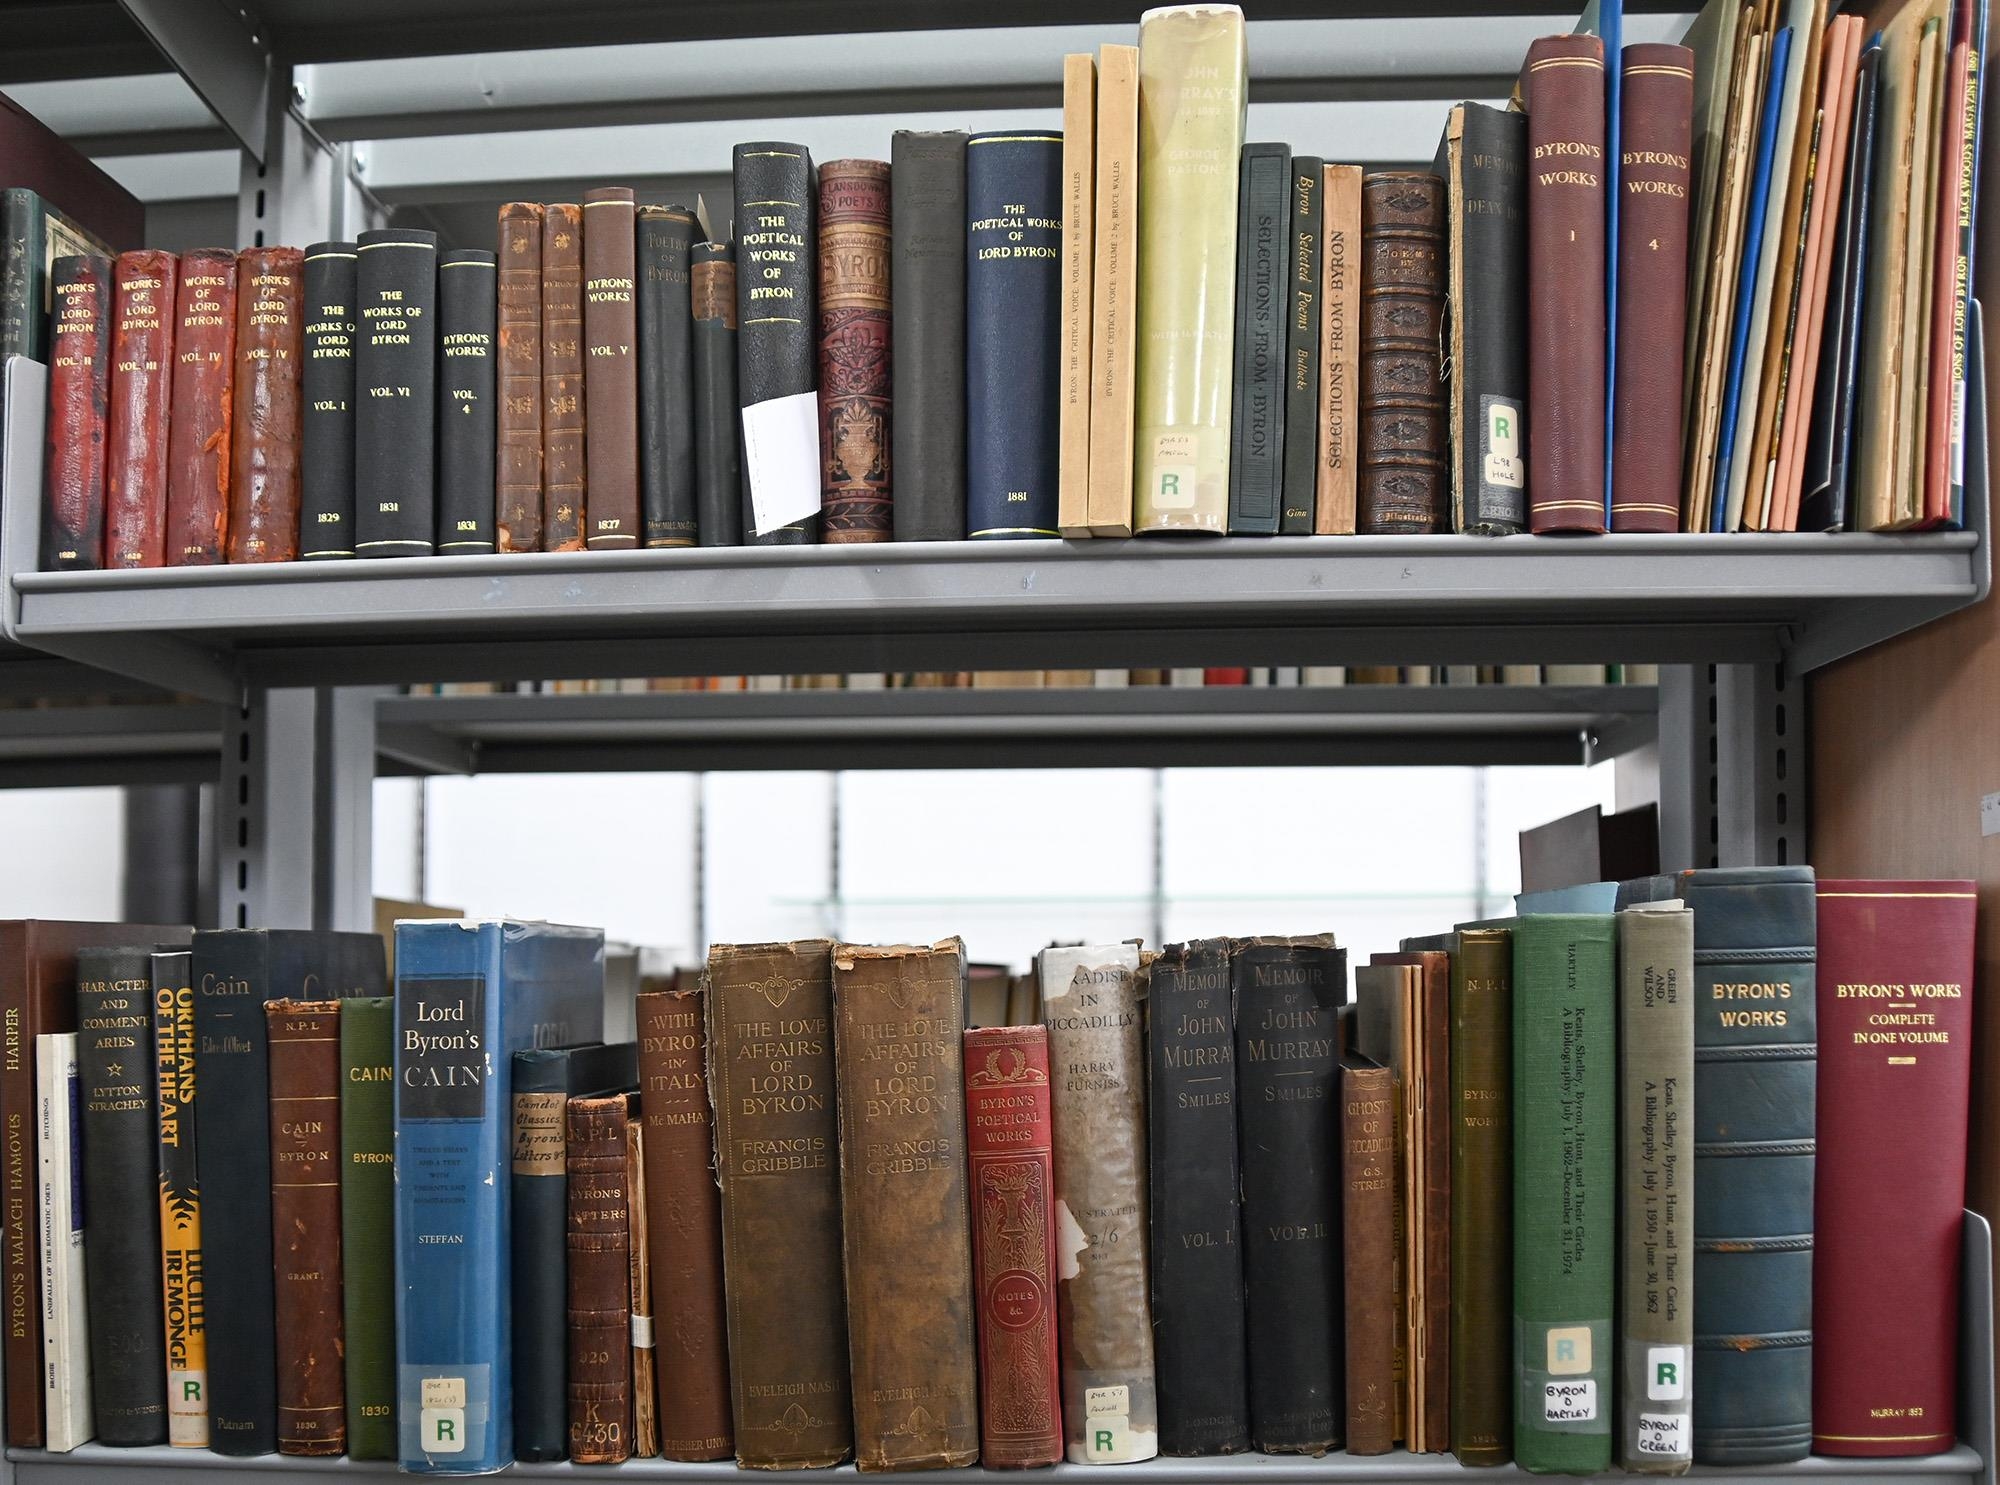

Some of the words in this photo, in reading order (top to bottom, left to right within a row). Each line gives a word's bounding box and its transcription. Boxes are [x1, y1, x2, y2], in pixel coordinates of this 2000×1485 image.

[1963, 78, 1977, 139] MAGAZINE
[1534, 143, 1600, 160] BYRON'S
[1623, 153, 1687, 169] BYRON'S
[1112, 161, 1121, 190] WALLIS
[1539, 171, 1598, 186] WORKS
[1073, 171, 1081, 200] WALLIS
[1628, 182, 1684, 197] WORKS
[1296, 176, 1314, 215] Byron
[1003, 205, 1025, 214] THE
[1111, 193, 1120, 219] BRUCE
[758, 216, 785, 227] THE
[972, 217, 1023, 230] POETICAL
[1027, 218, 1062, 230] WORKS
[743, 233, 803, 246] POETICAL
[1008, 231, 1024, 241] OF
[750, 250, 796, 261] WORKS
[979, 248, 1010, 259] LORD
[1014, 247, 1056, 258] BYRON
[1109, 241, 1118, 274] VOLUME
[1298, 232, 1313, 282] Selected
[1331, 230, 1344, 290] BYRON
[763, 268, 781, 279] OF
[1071, 251, 1080, 283] VOLUME
[184, 276, 225, 286] WORKS
[251, 275, 290, 286] WORKS
[1955, 255, 1967, 297] BYRON
[56, 284, 95, 295] WORKS
[122, 279, 161, 290] WORKS
[587, 279, 632, 290] BYRON'S
[132, 293, 147, 301] OF
[196, 289, 210, 298] OF
[261, 288, 276, 296] OF
[380, 291, 402, 301] THE
[589, 291, 629, 302] WORKS
[750, 287, 793, 299] BYRON
[67, 295, 81, 305] OF
[254, 301, 284, 312] LORD
[62, 308, 91, 319] LORD
[127, 304, 156, 315] LORD
[189, 302, 220, 313] LORD
[322, 305, 344, 315] THE
[363, 307, 402, 317] WORKS
[406, 307, 422, 316] OF
[1298, 290, 1313, 331] Poems
[184, 315, 222, 326] BYRON
[250, 314, 287, 325] BYRON
[1954, 300, 1966, 332] LORD
[57, 322, 94, 334] BYRON
[122, 319, 159, 330] BYRON
[306, 322, 343, 333] WORKS
[376, 320, 406, 330] LORD
[1107, 310, 1116, 344] CRITICAL
[1330, 301, 1344, 351] FROM
[318, 335, 348, 345] LORD
[371, 334, 409, 345] BYRON
[444, 334, 489, 345] BYRON'S
[1070, 317, 1079, 352] CRITICAL
[209, 352, 220, 361] IV
[276, 350, 286, 359] IV
[313, 348, 350, 358] BYRON
[446, 346, 486, 357] WORKS
[591, 346, 615, 355] VOL.
[620, 345, 628, 354] V
[398, 387, 410, 396] VI
[453, 390, 477, 399] VOL.
[1329, 362, 1344, 469] SELECTIONS
[1251, 394, 1267, 457] BYRON
[1495, 417, 1509, 439] R
[1161, 473, 1179, 495] R
[1007, 492, 1026, 501] 1881
[379, 503, 398, 512] 1831
[1287, 508, 1307, 517] Ginn
[318, 513, 339, 523] 1829
[598, 520, 619, 530] 1827
[1568, 944, 1577, 991] HARTLEY
[1255, 966, 1324, 986] MEMOIR
[201, 973, 250, 996] Cain
[1644, 966, 1654, 1008] WILSON
[1656, 974, 1665, 999] AND
[1667, 968, 1676, 1004] GREEN
[1712, 983, 1791, 999] BYRON'S
[1837, 984, 1904, 998] BYRON'S
[1911, 984, 1961, 997] WORKS
[100, 1000, 127, 1009] AND
[157, 987, 174, 1018] OF
[1081, 994, 1098, 1006] IN
[417, 1000, 464, 1022] Lord
[1047, 1014, 1135, 1030] PICCADILLY
[1262, 1009, 1317, 1030] JOHN
[1720, 1011, 1787, 1026] WORKS
[1870, 1014, 1934, 1024] COMPLETE
[735, 1023, 771, 1038] THE
[780, 1019, 828, 1035] LOVE
[858, 1025, 896, 1039] THE
[904, 1021, 950, 1037] LOVE
[1178, 1015, 1226, 1036] JOHN
[6, 1007, 19, 1071] HARPER
[95, 1037, 135, 1048] ARIES
[405, 1030, 479, 1056] Byron's
[1854, 1033, 1868, 1043] IN
[1871, 1033, 1896, 1042] ONE
[1899, 1032, 1948, 1042] VOLUME
[158, 1023, 176, 1067] THE
[737, 1042, 822, 1060] AFFAIRS
[862, 1041, 945, 1062] AFFAIRS
[1249, 1039, 1331, 1062] MURRAY
[771, 1061, 792, 1072] OF
[895, 1062, 917, 1073] OF
[1069, 1062, 1115, 1073] HARRY
[350, 1068, 392, 1081] CAIN
[404, 1066, 479, 1087] CAIN
[752, 1075, 812, 1093] LORD
[875, 1076, 936, 1095] LORD
[1068, 1079, 1120, 1091] FURNISS
[94, 1086, 140, 1097] LYTTON
[1265, 1087, 1323, 1101] SMILES
[88, 1100, 147, 1111] STRACHEY
[743, 1095, 823, 1115] BYRON
[866, 1097, 948, 1117] BYRON
[980, 1095, 1034, 1109] BYRON'S
[1178, 1092, 1231, 1109] SMILES
[159, 1071, 178, 1148] HEART
[976, 1113, 1040, 1126] POETICAL
[282, 1122, 321, 1134] CAIN
[1363, 1121, 1379, 1133] OF
[986, 1131, 1032, 1142] WORKS
[9, 1113, 22, 1190] HAMOVES
[743, 1138, 824, 1154] FRANCIS
[867, 1139, 950, 1156] FRANCIS
[280, 1151, 329, 1160] BYRON
[353, 1153, 393, 1163] BYRON
[742, 1155, 826, 1172] GRIBBLE
[866, 1157, 948, 1175] GRIBBLE
[10, 1198, 24, 1266] MALACH
[1091, 1227, 1118, 1248] 2/6
[419, 1235, 463, 1243] STEFFAN
[185, 1249, 204, 1336] LUCILLE
[999, 1291, 1034, 1300] NOTES
[1556, 1339, 1575, 1360] R
[1658, 1363, 1676, 1385] R
[184, 1381, 200, 1401] R
[1546, 1384, 1587, 1395] BYRON
[361, 1405, 390, 1416] 1830
[1547, 1408, 1590, 1419] HARTLEY
[1871, 1408, 1904, 1418] MURRAY
[437, 1419, 455, 1440] R
[1095, 1431, 1113, 1451] R
